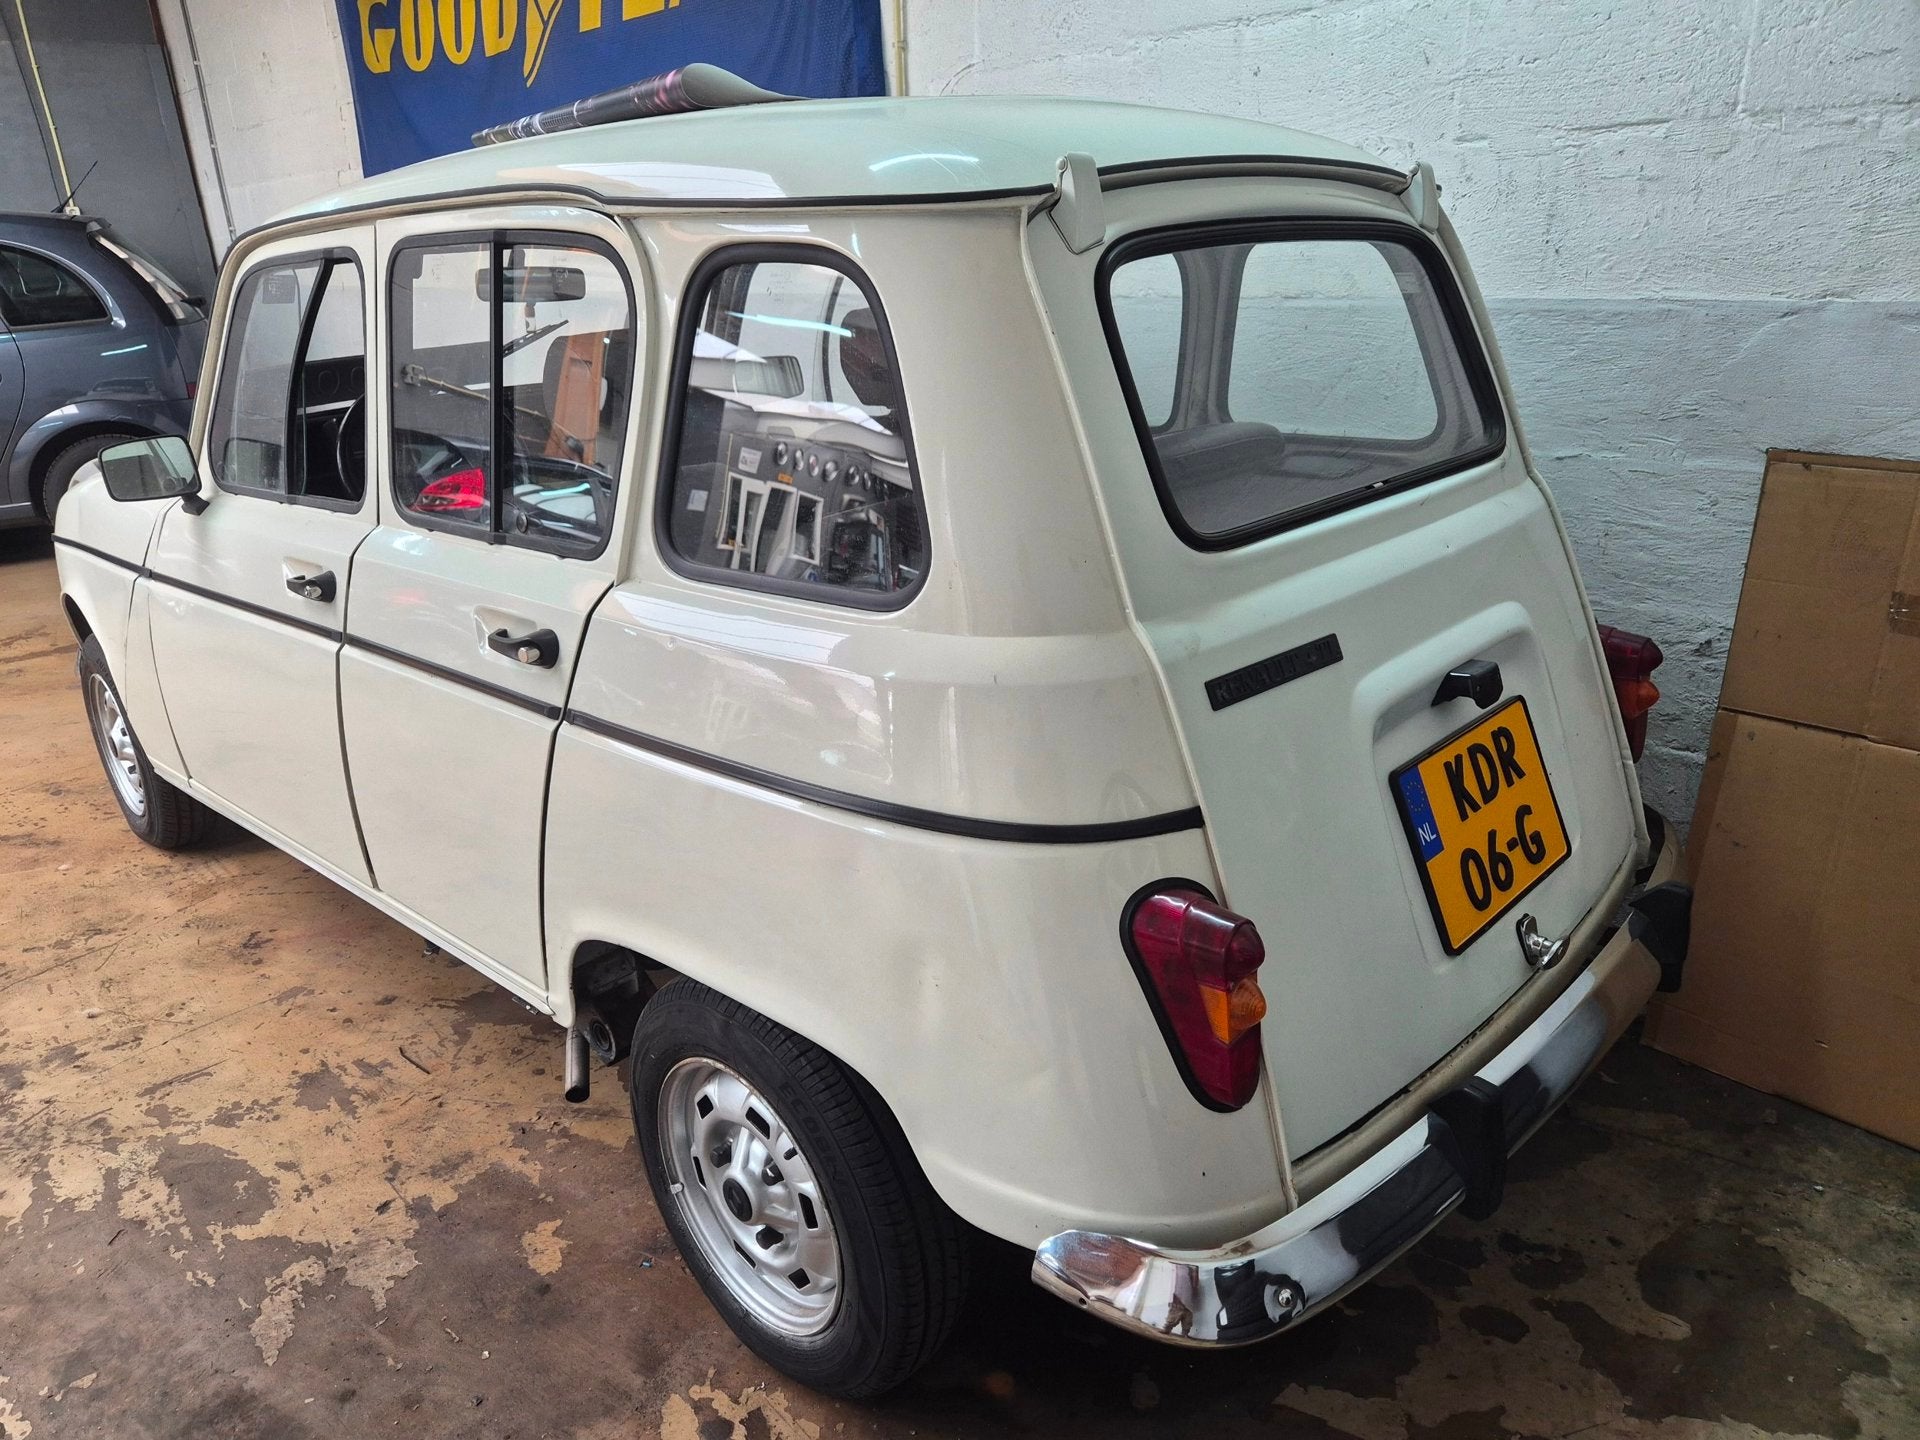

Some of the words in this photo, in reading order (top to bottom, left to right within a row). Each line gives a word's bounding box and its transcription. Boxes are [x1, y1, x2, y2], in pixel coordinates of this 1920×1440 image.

[1443, 726, 1526, 823] KDR
[1417, 822, 1437, 847] NL
[1460, 804, 1547, 912] 06-G
